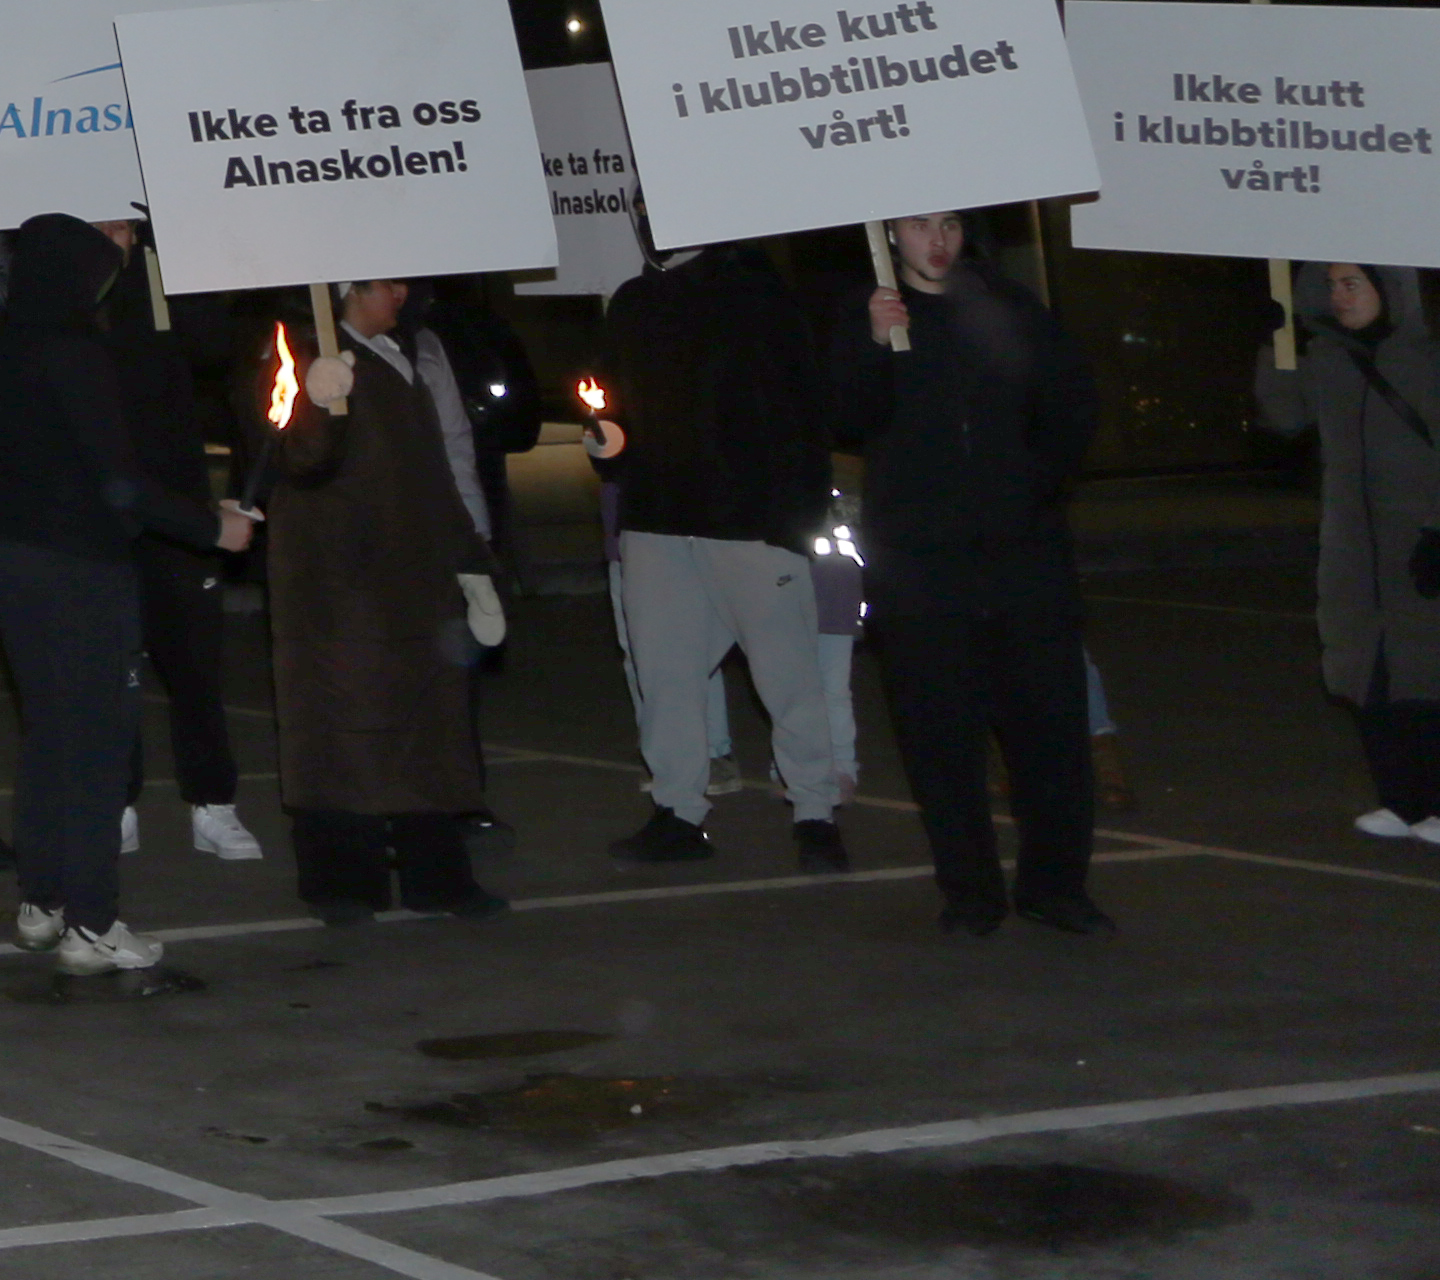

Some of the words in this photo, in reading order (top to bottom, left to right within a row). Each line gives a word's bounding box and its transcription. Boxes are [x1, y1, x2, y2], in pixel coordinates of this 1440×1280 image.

[727, 20, 826, 59] Ikke
[836, 0, 938, 43] kutt
[672, 83, 689, 118] i
[699, 40, 1019, 115] klubbtilbudet
[1173, 73, 1262, 104] Ikke
[1275, 76, 1365, 108] kutt
[188, 108, 279, 143] Ikke
[288, 105, 331, 135] ta
[341, 99, 401, 131] fra
[412, 99, 482, 126] oss
[799, 104, 910, 150] vårt!
[1114, 111, 1125, 142] i
[1138, 115, 1433, 155] klubbtilbudet
[224, 141, 468, 189] Alnaskolen!
[568, 152, 588, 175] ta
[593, 148, 625, 174] fra
[1220, 159, 1321, 193] vårt!
[551, 187, 627, 215] lnaskol
